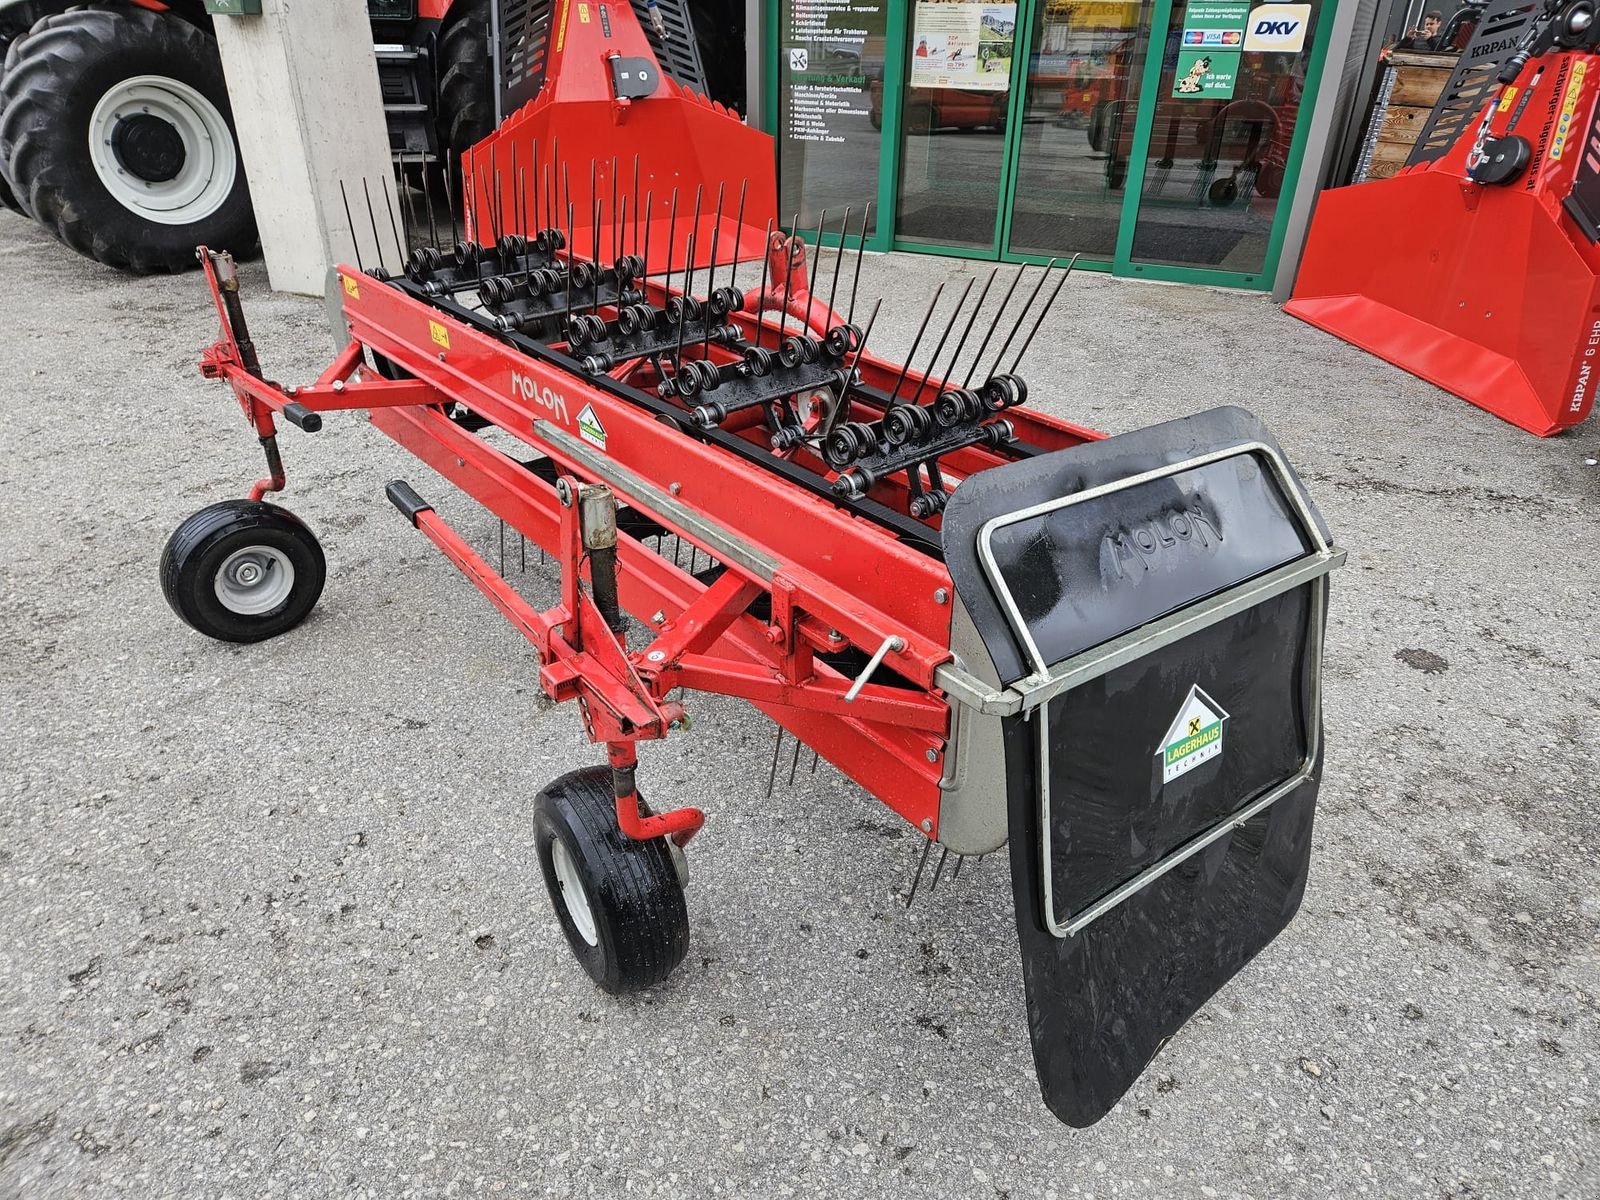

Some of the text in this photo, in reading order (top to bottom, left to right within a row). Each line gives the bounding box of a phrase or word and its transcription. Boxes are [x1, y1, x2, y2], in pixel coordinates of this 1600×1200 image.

[1255, 22, 1299, 35] DKV
[1471, 35, 1520, 58] KRPAN
[835, 74, 865, 83] Verkauf
[1526, 56, 1570, 191] salzburger-lagerhaus.at
[512, 369, 570, 425] MOLON
[1570, 364, 1592, 412] KRPAN
[1106, 504, 1223, 579] MOLON
[1168, 726, 1219, 763] LAGERHAUS
[1168, 744, 1218, 775] TECHNIK
